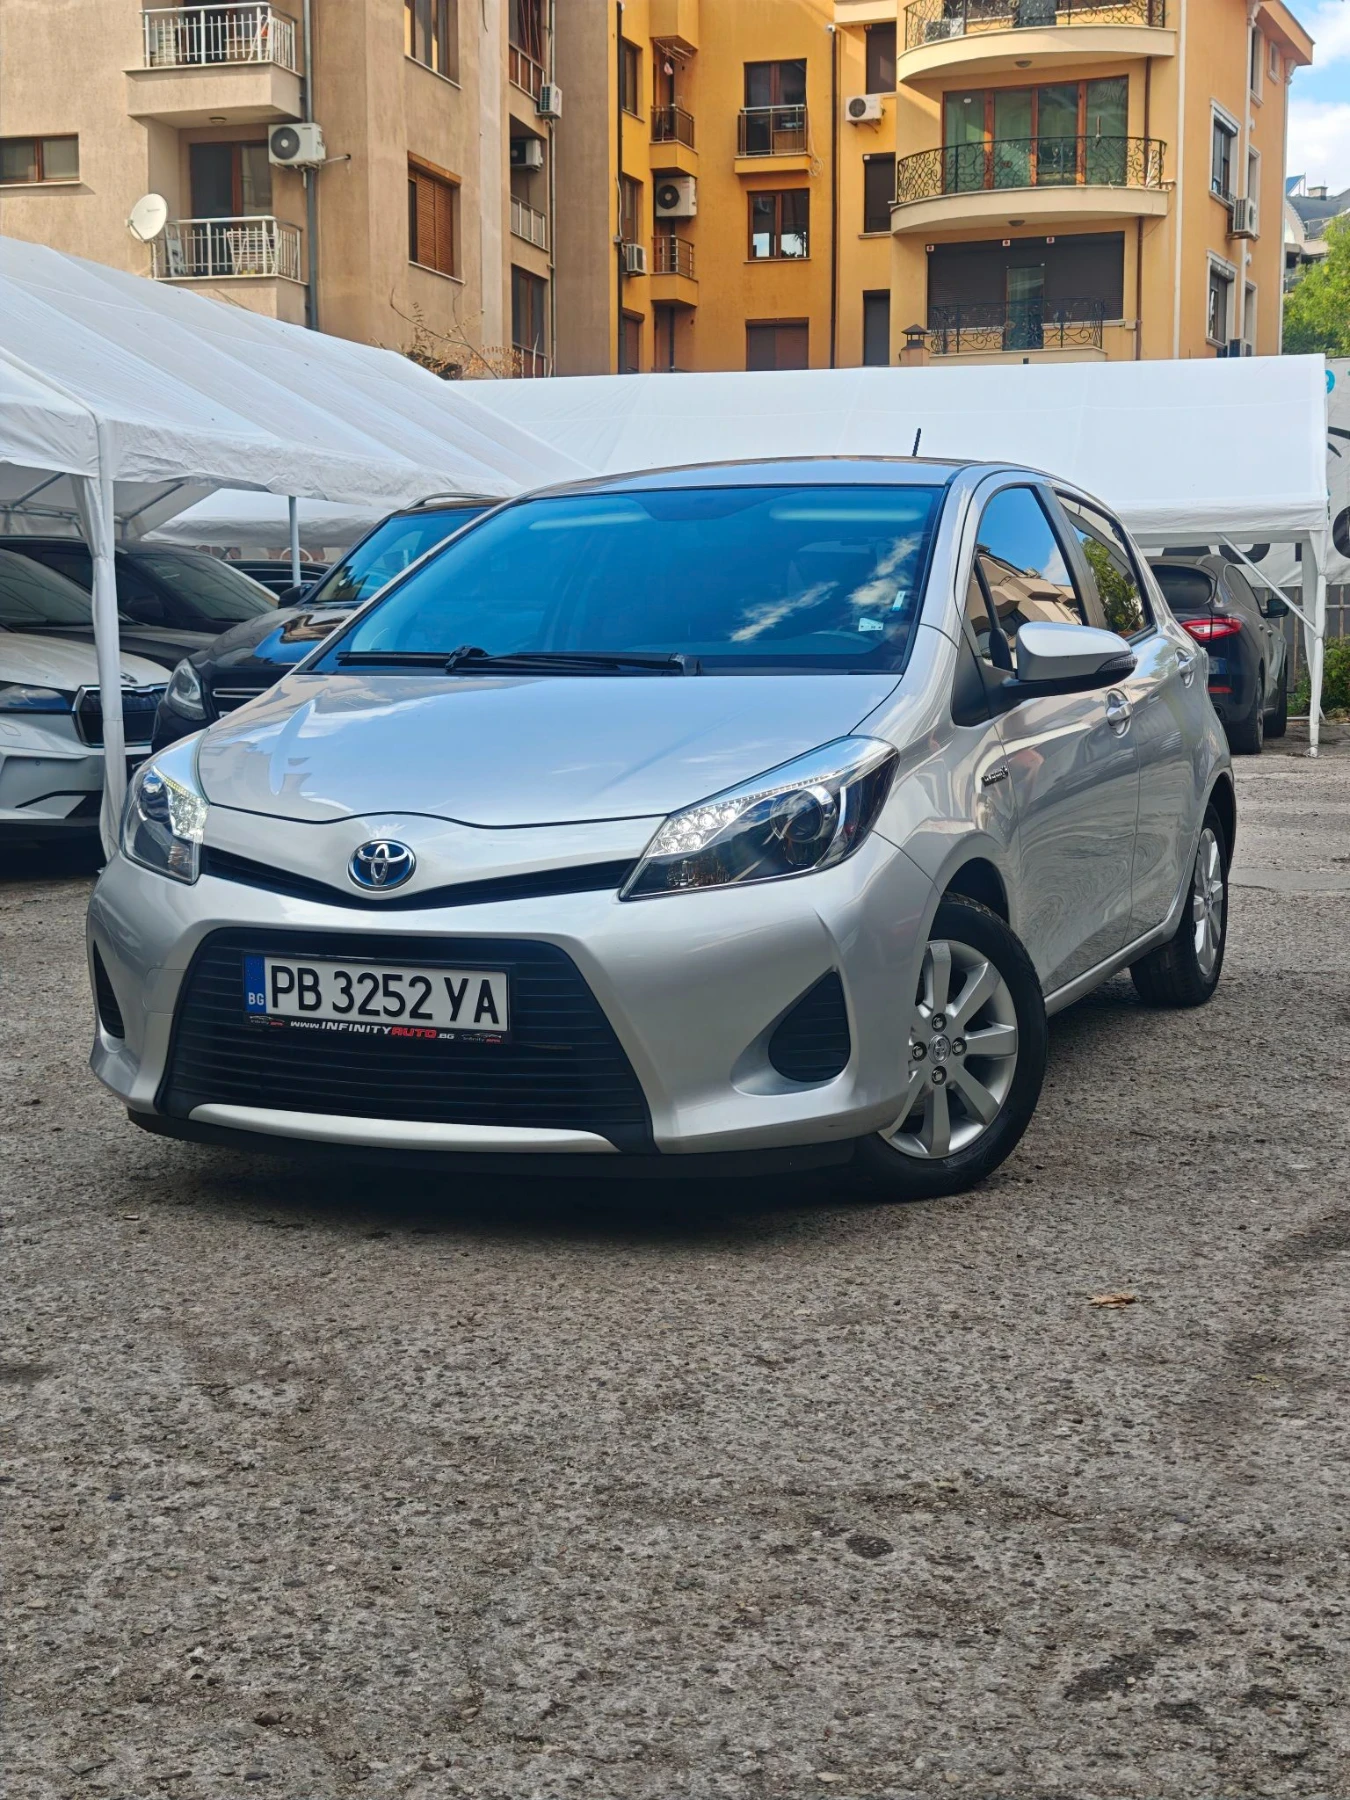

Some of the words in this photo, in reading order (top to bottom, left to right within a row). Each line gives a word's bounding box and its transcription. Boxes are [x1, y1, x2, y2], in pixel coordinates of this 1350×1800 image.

[248, 992, 265, 1006] BG
[271, 964, 322, 1011] PB
[332, 970, 433, 1020] 3252
[444, 976, 499, 1024] YA
